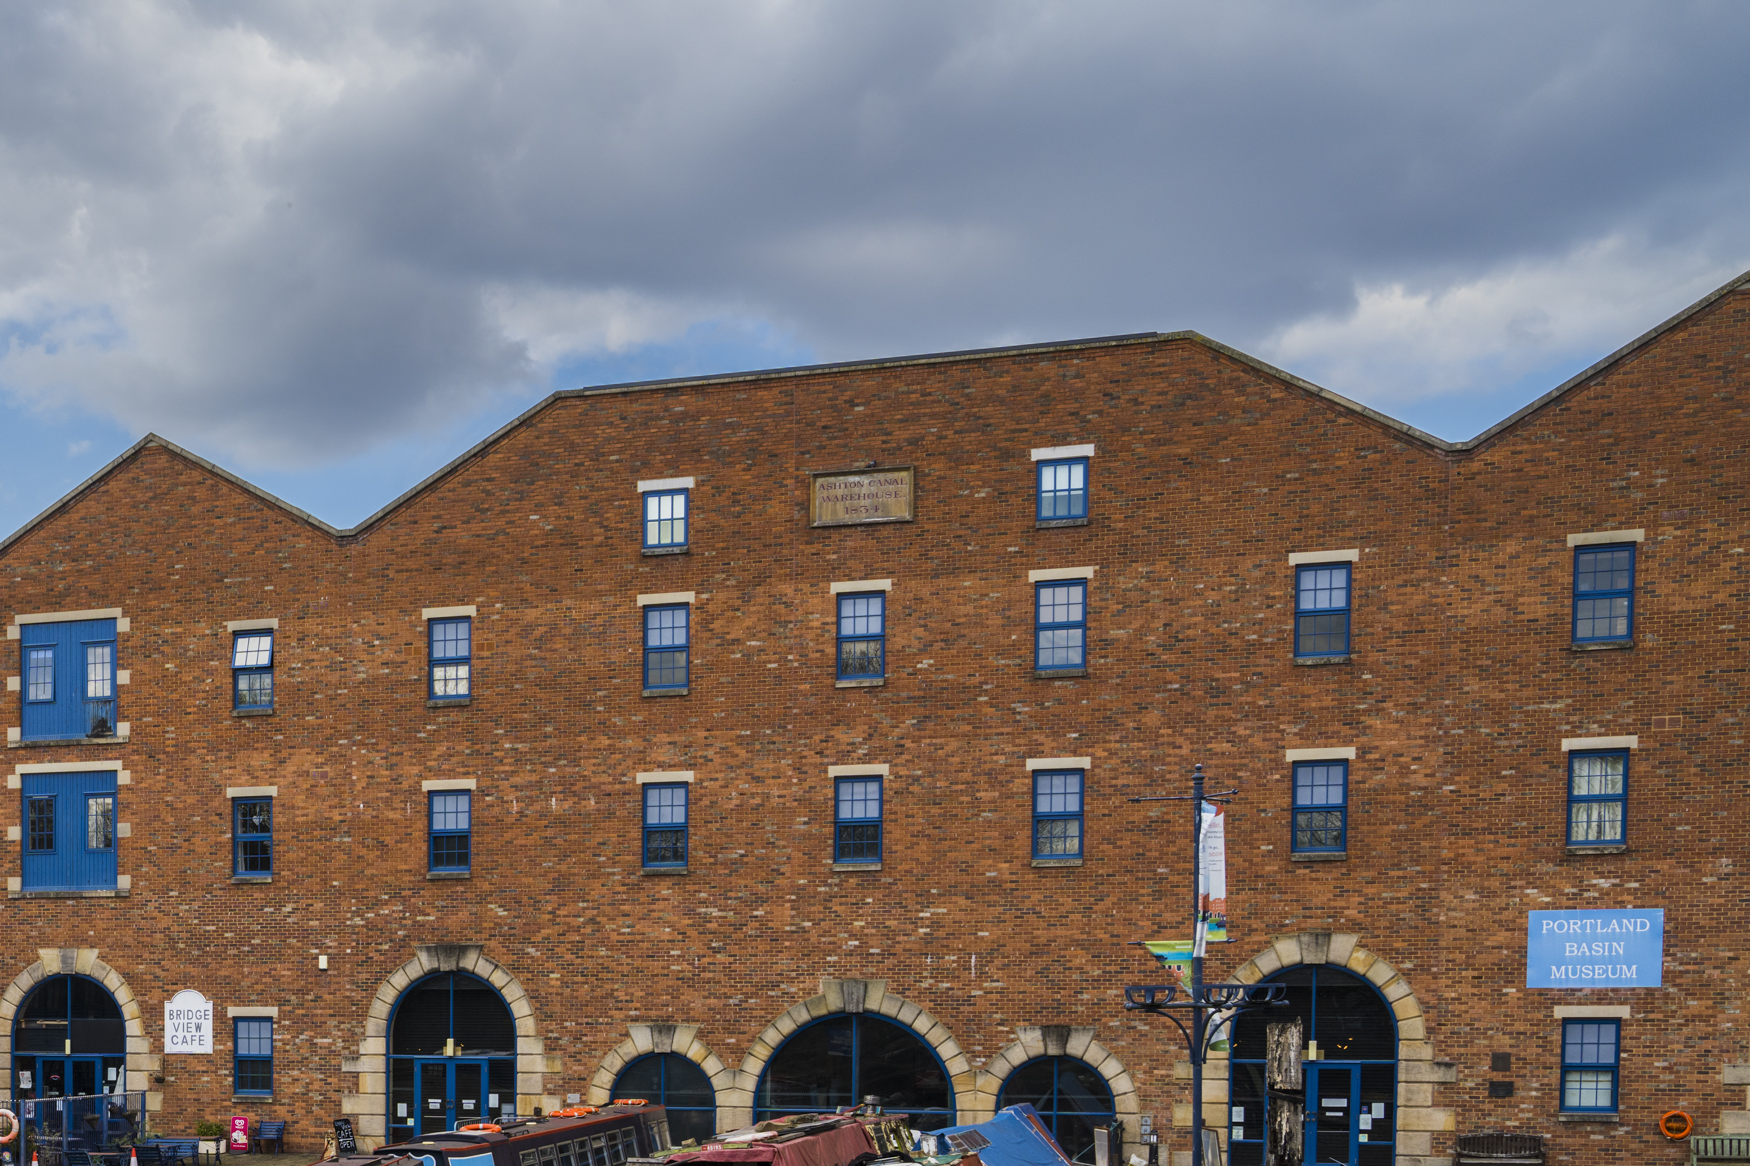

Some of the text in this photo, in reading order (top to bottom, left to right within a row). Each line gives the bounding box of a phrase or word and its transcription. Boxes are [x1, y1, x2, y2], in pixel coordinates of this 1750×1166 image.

[818, 478, 908, 491] ASHTON CANAL
[821, 490, 906, 503] WAREHOUSE.
[1541, 918, 1650, 934] PORTLAND
[1564, 942, 1625, 956] BASIN
[1550, 965, 1638, 979] MUSEUM
[168, 1009, 210, 1021] BRIDGE
[172, 1022, 203, 1033] VIEW
[170, 1034, 205, 1046] CAFE
[336, 1129, 353, 1139] CAFE
[340, 1141, 355, 1149] OPEN
